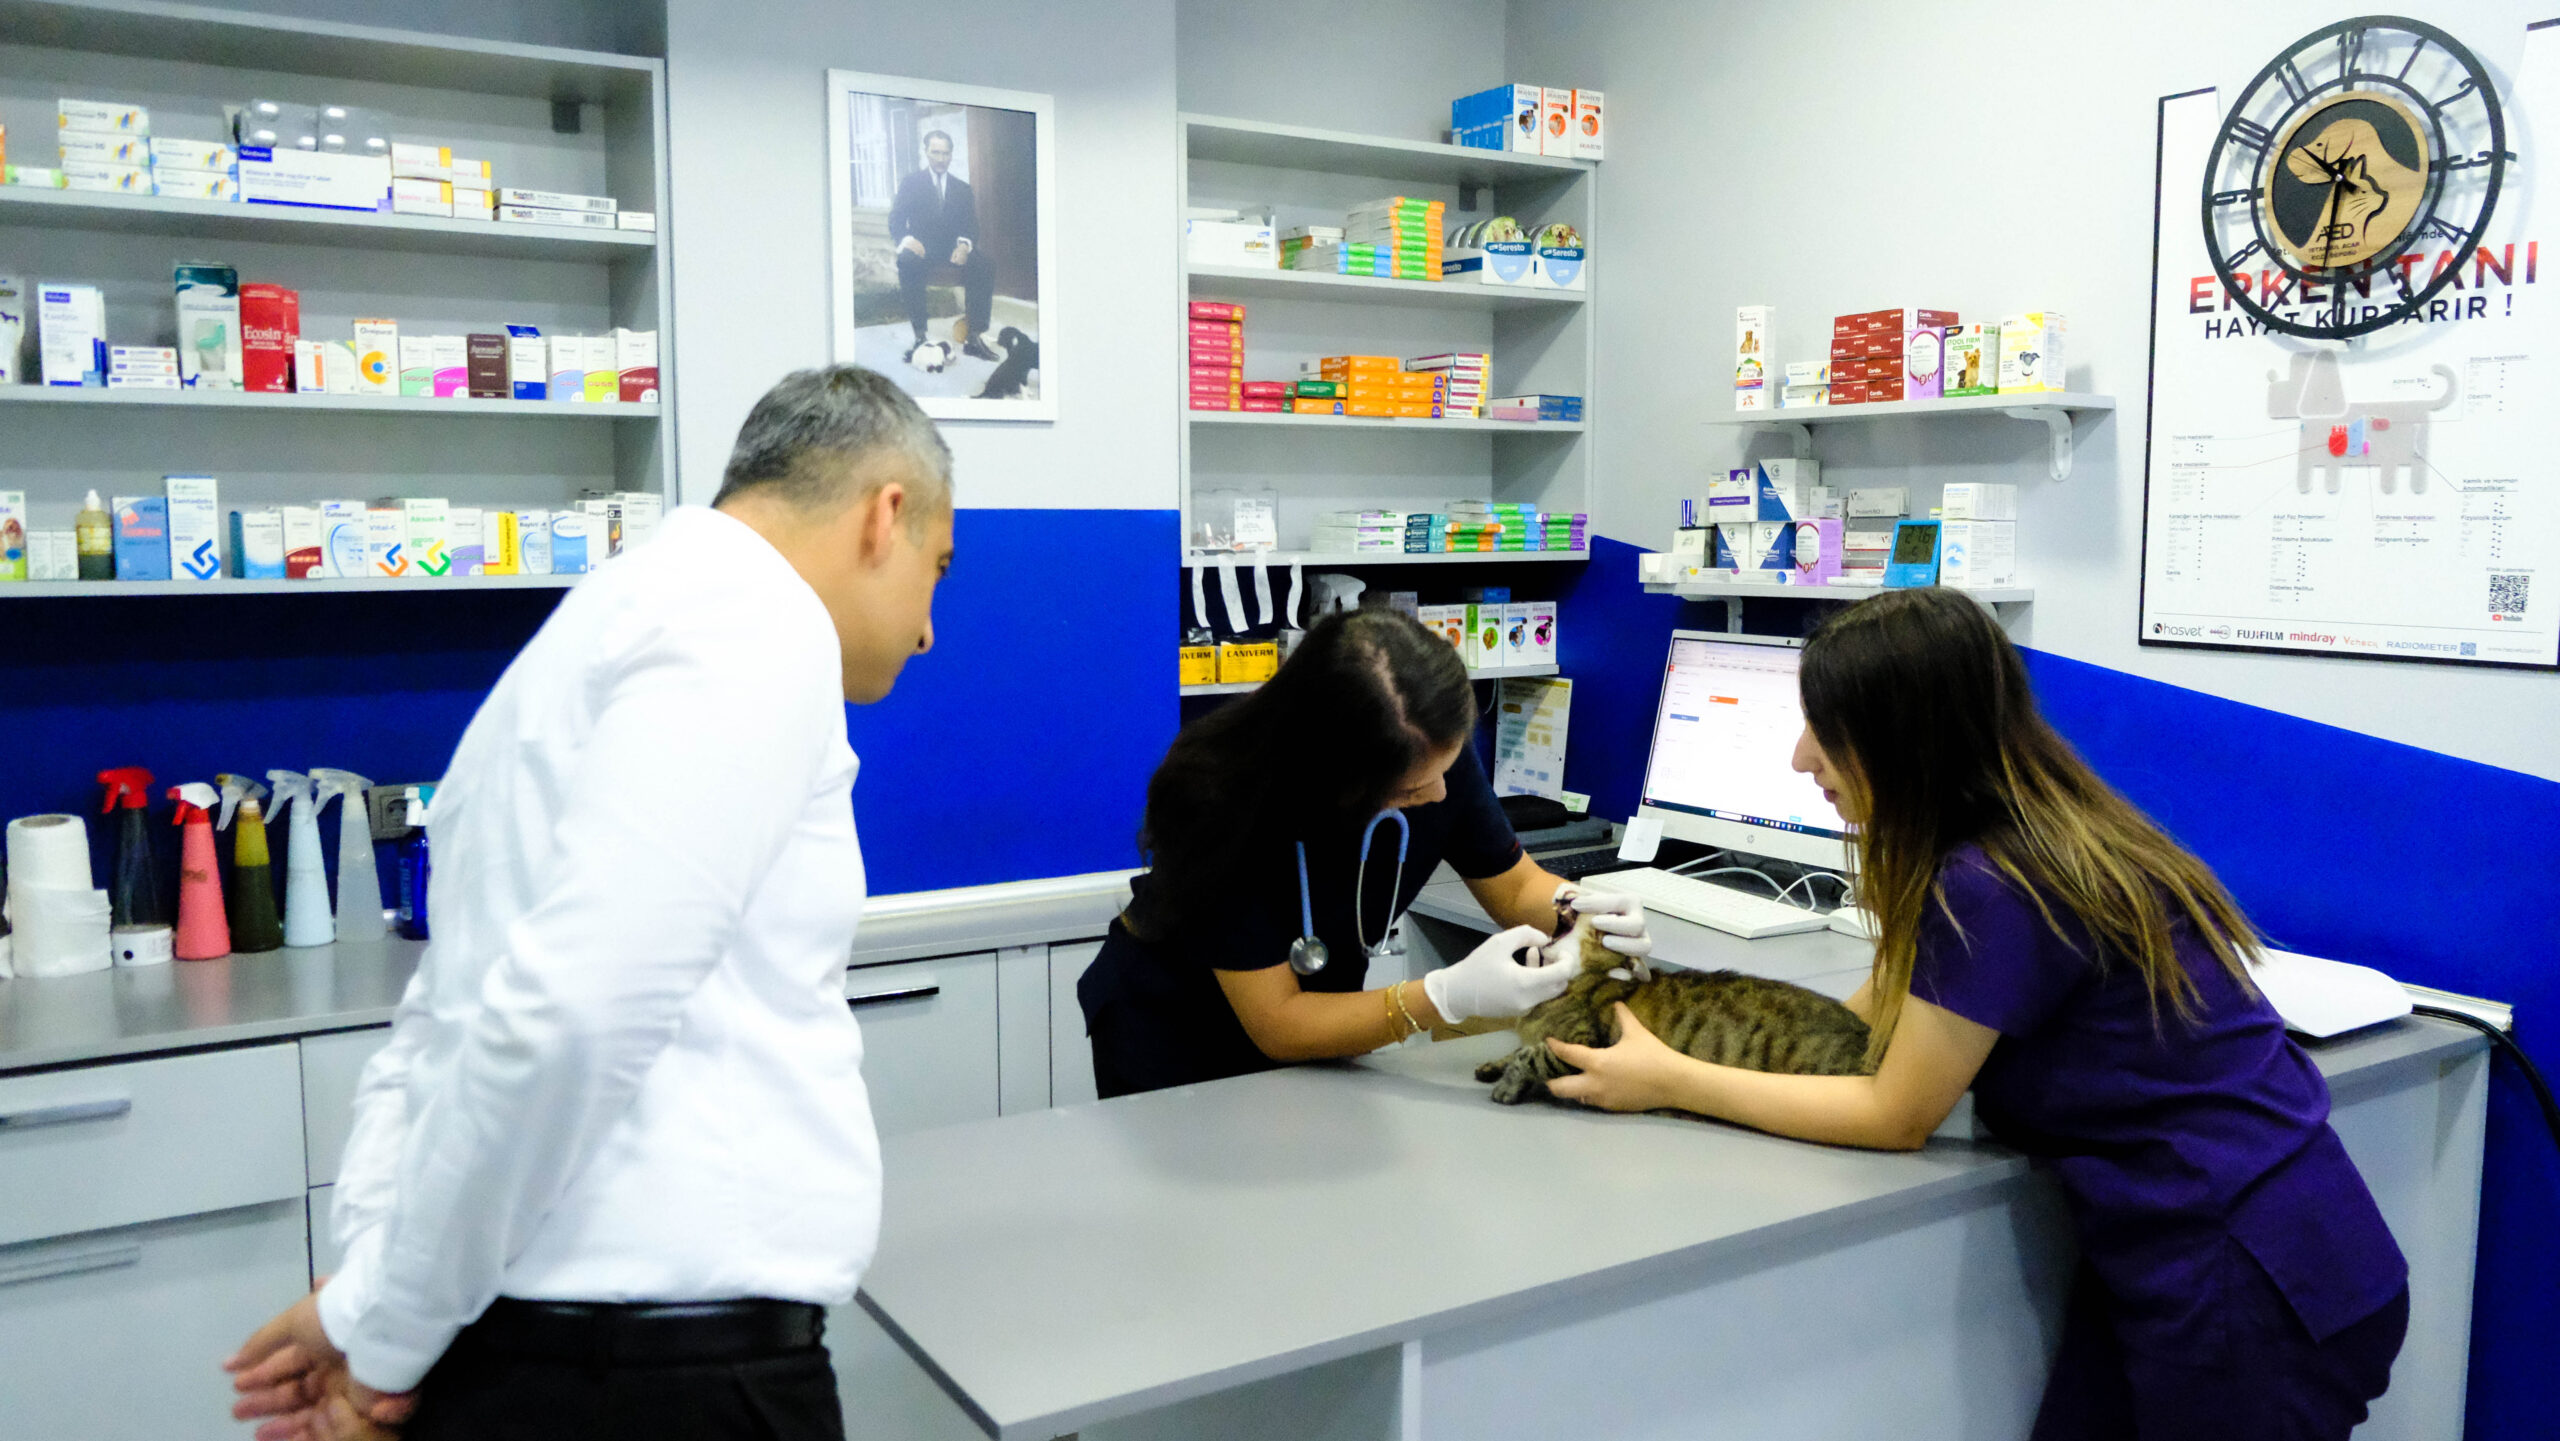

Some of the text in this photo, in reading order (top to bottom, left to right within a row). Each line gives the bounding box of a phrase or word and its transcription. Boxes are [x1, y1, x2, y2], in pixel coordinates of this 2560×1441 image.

[1498, 243, 1526, 253] Seresto
[1551, 248, 1579, 258] Seresto
[1441, 263, 1463, 273] resto
[2189, 240, 2539, 314] ERKEN TANI
[1946, 336, 1981, 346] STOOL FIRM
[2163, 623, 2202, 637] hasvet
[2237, 629, 2284, 641] FUJIFILM
[2289, 631, 2337, 646] mindray
[2386, 640, 2458, 653] RADIOMETER
[1180, 650, 1212, 660] IVERM
[1226, 648, 1274, 658] CANIVERM
